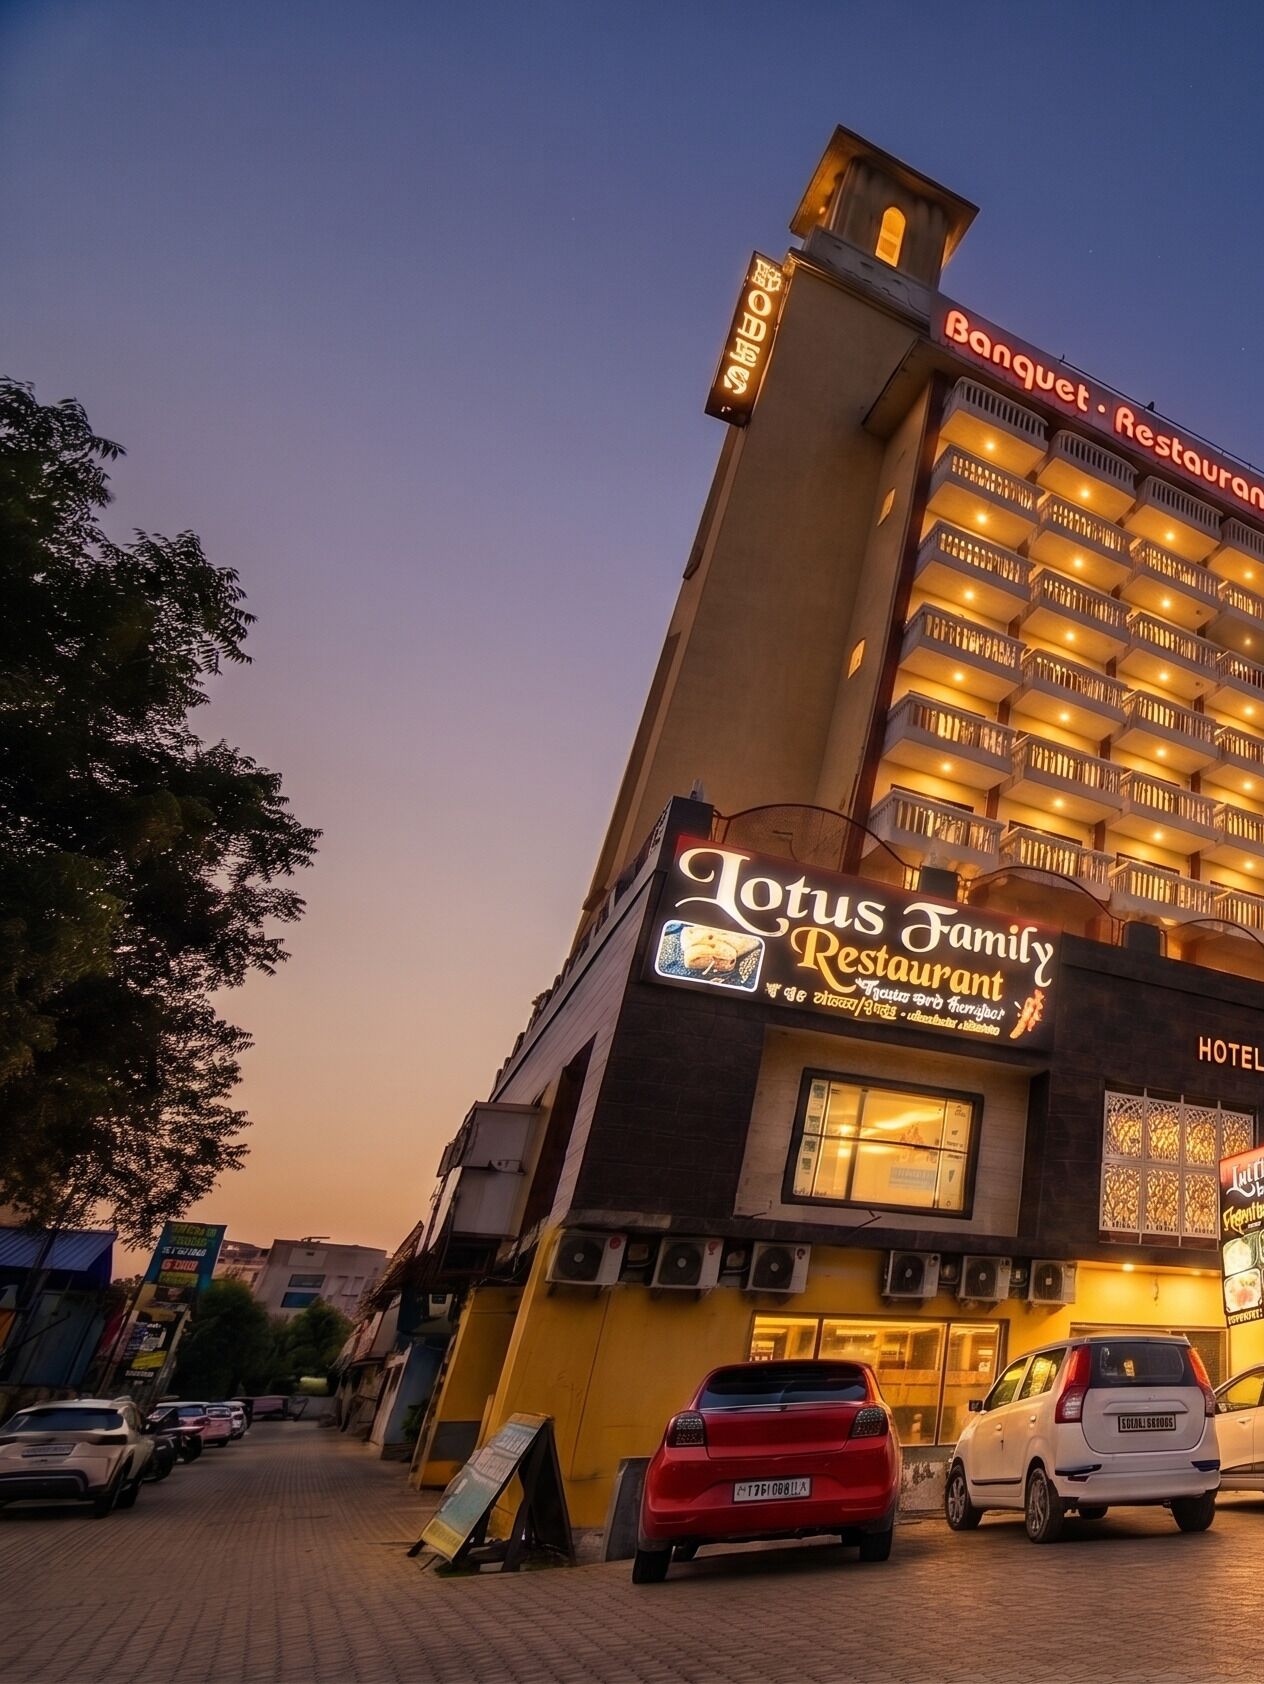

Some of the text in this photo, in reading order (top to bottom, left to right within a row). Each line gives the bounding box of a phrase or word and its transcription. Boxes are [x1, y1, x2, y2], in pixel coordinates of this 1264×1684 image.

[945, 310, 1090, 413] Banquet
[675, 846, 1054, 988] Lotus Family
[790, 925, 1006, 1002] Restaurant
[1199, 1036, 1264, 1072] HOTEL
